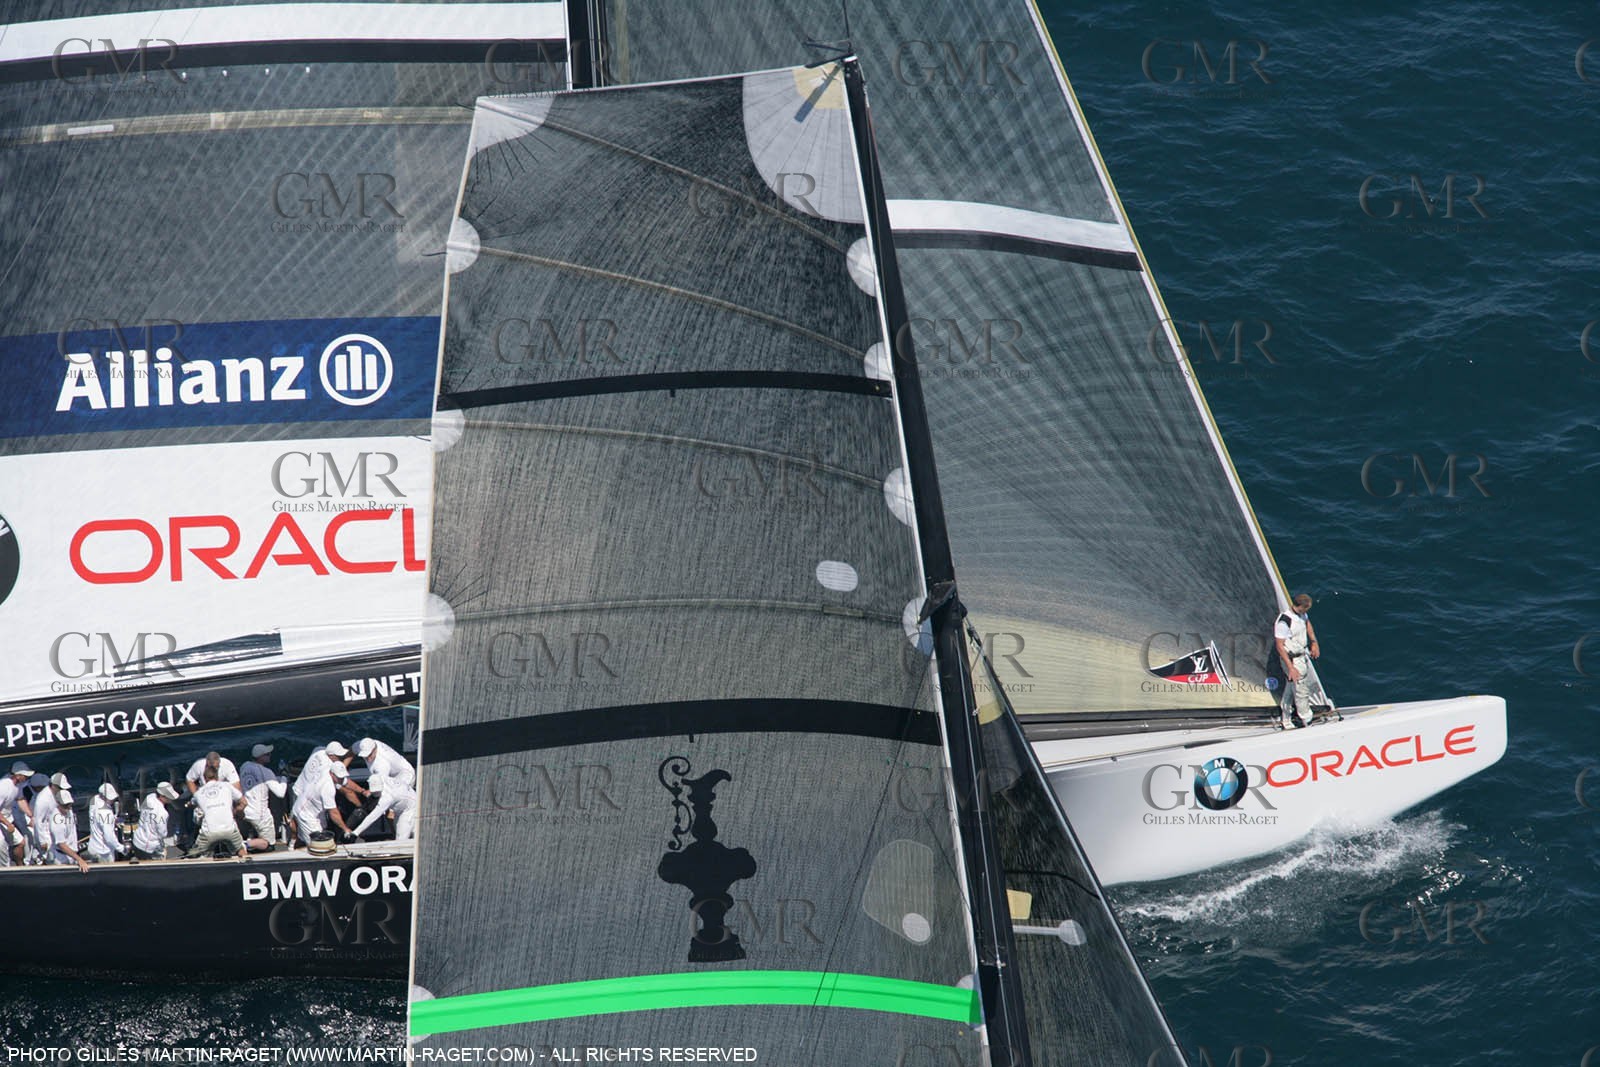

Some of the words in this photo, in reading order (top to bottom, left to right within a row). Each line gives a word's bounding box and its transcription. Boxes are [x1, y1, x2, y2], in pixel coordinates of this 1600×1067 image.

[55, 347, 306, 411] Allianz
[69, 508, 426, 584] ORACL
[368, 671, 421, 699] NET
[1266, 724, 1477, 788] ORACLE
[241, 868, 341, 901] BMW
[350, 865, 413, 895] OR
